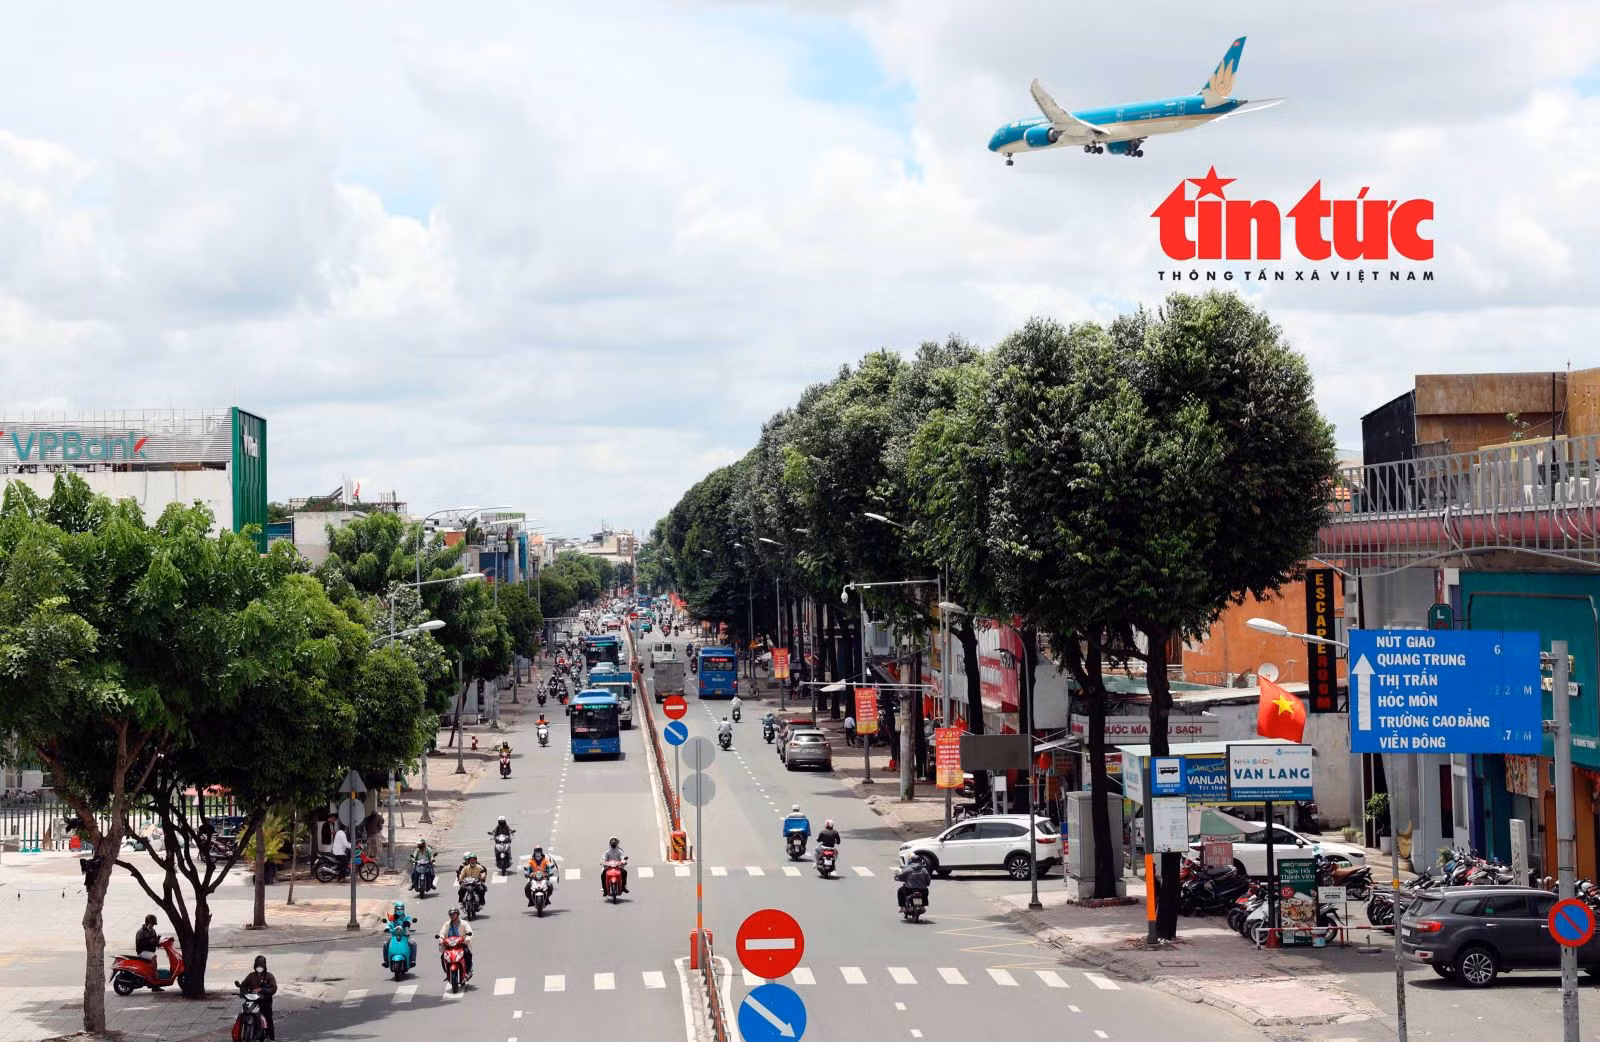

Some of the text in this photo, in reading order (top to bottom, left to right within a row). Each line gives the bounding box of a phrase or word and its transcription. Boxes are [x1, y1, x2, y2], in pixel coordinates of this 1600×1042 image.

[11, 431, 150, 461] VPBank
[1315, 573, 1327, 654] ESCAPE
[1376, 631, 1435, 648] NÚT GIAO
[1377, 653, 1466, 667] QUANG TRUNG
[1378, 668, 1438, 690] THỊ TRẤN
[1378, 691, 1438, 707] HÓC MÔN
[1379, 708, 1490, 728] TRƯỜNG CAO ĐẲNG
[1175, 726, 1202, 736] SẠCH
[1379, 730, 1446, 749] VIỄN ĐÔNG
[1187, 775, 1227, 785] VANLAN
[1269, 768, 1310, 779] LANG
